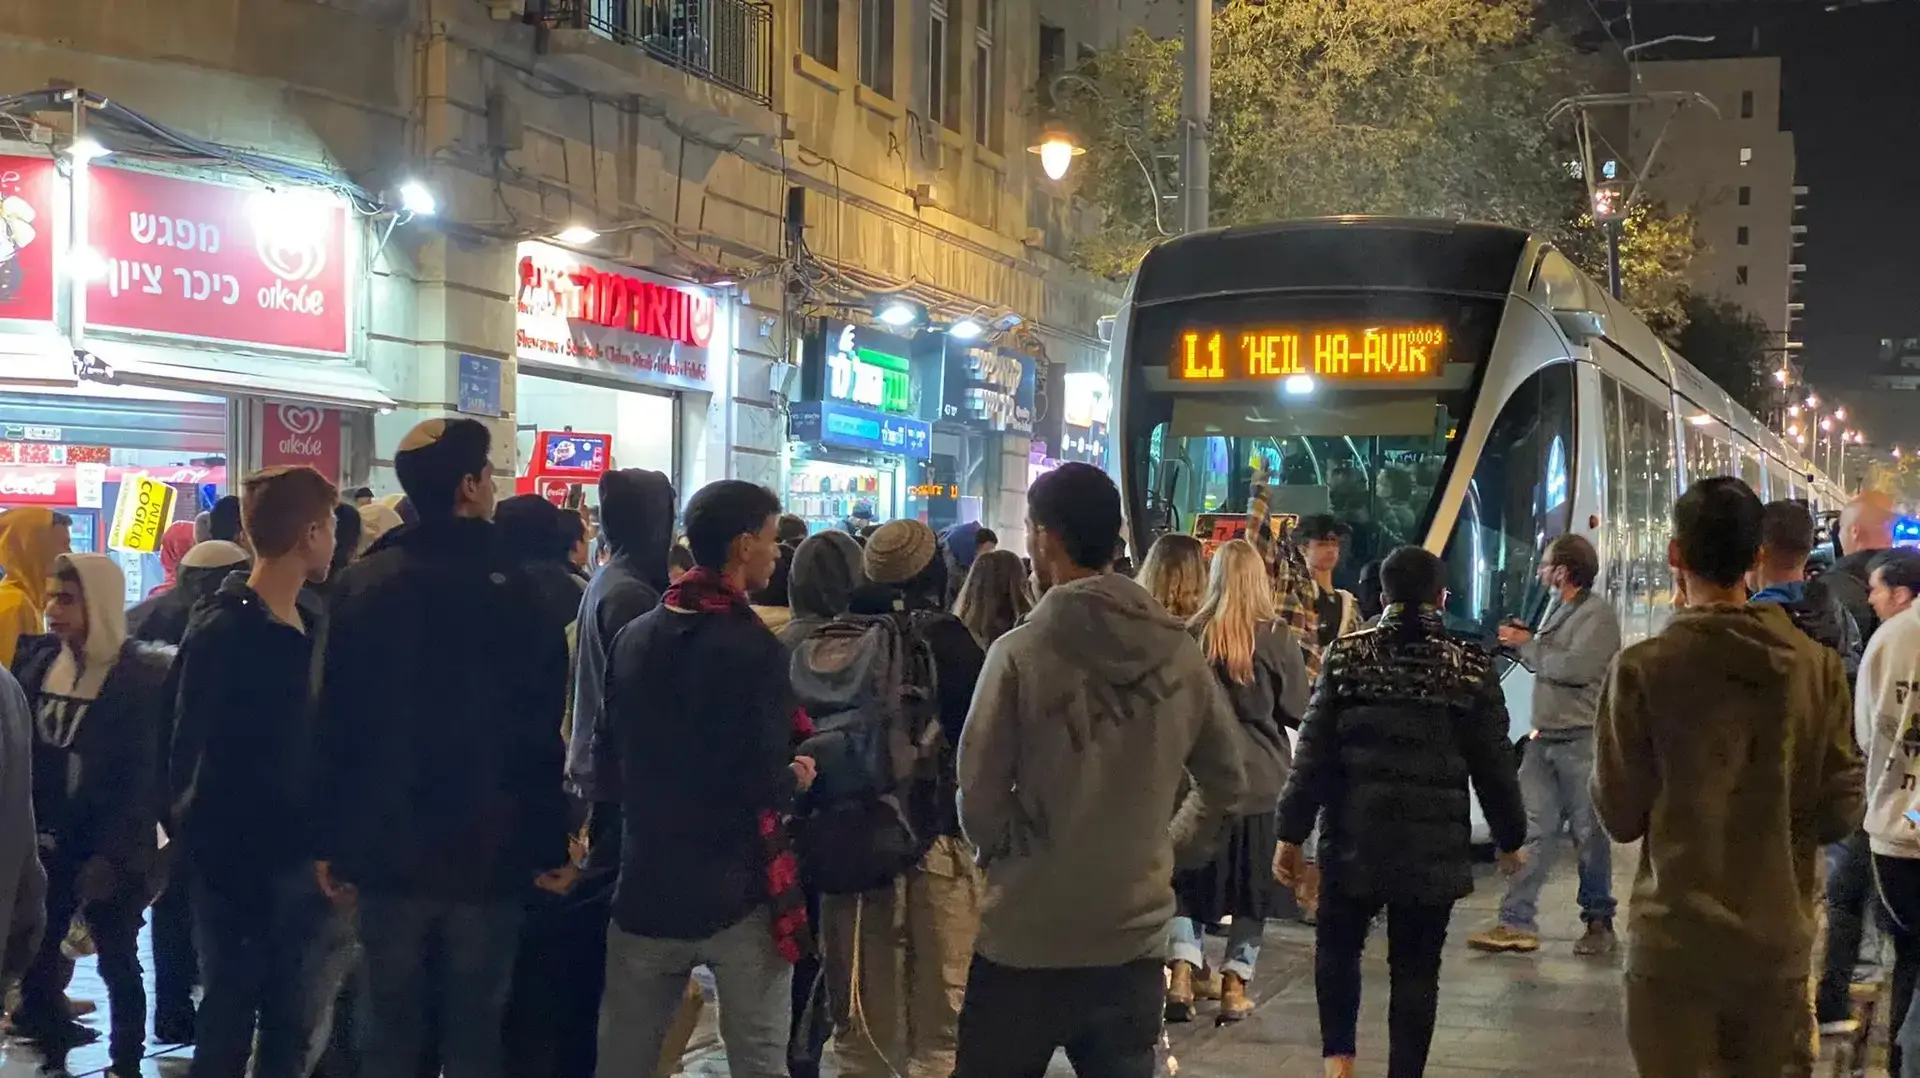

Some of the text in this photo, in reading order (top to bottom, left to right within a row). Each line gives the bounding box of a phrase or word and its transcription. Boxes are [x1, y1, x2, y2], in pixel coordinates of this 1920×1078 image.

[130, 210, 220, 253] מפגש
[108, 258, 240, 305] כיכר ציון
[257, 279, 324, 316] שטראוס
[1184, 334, 1225, 378] L1
[279, 433, 322, 456] שטראוס
[146, 502, 161, 537] ATM
